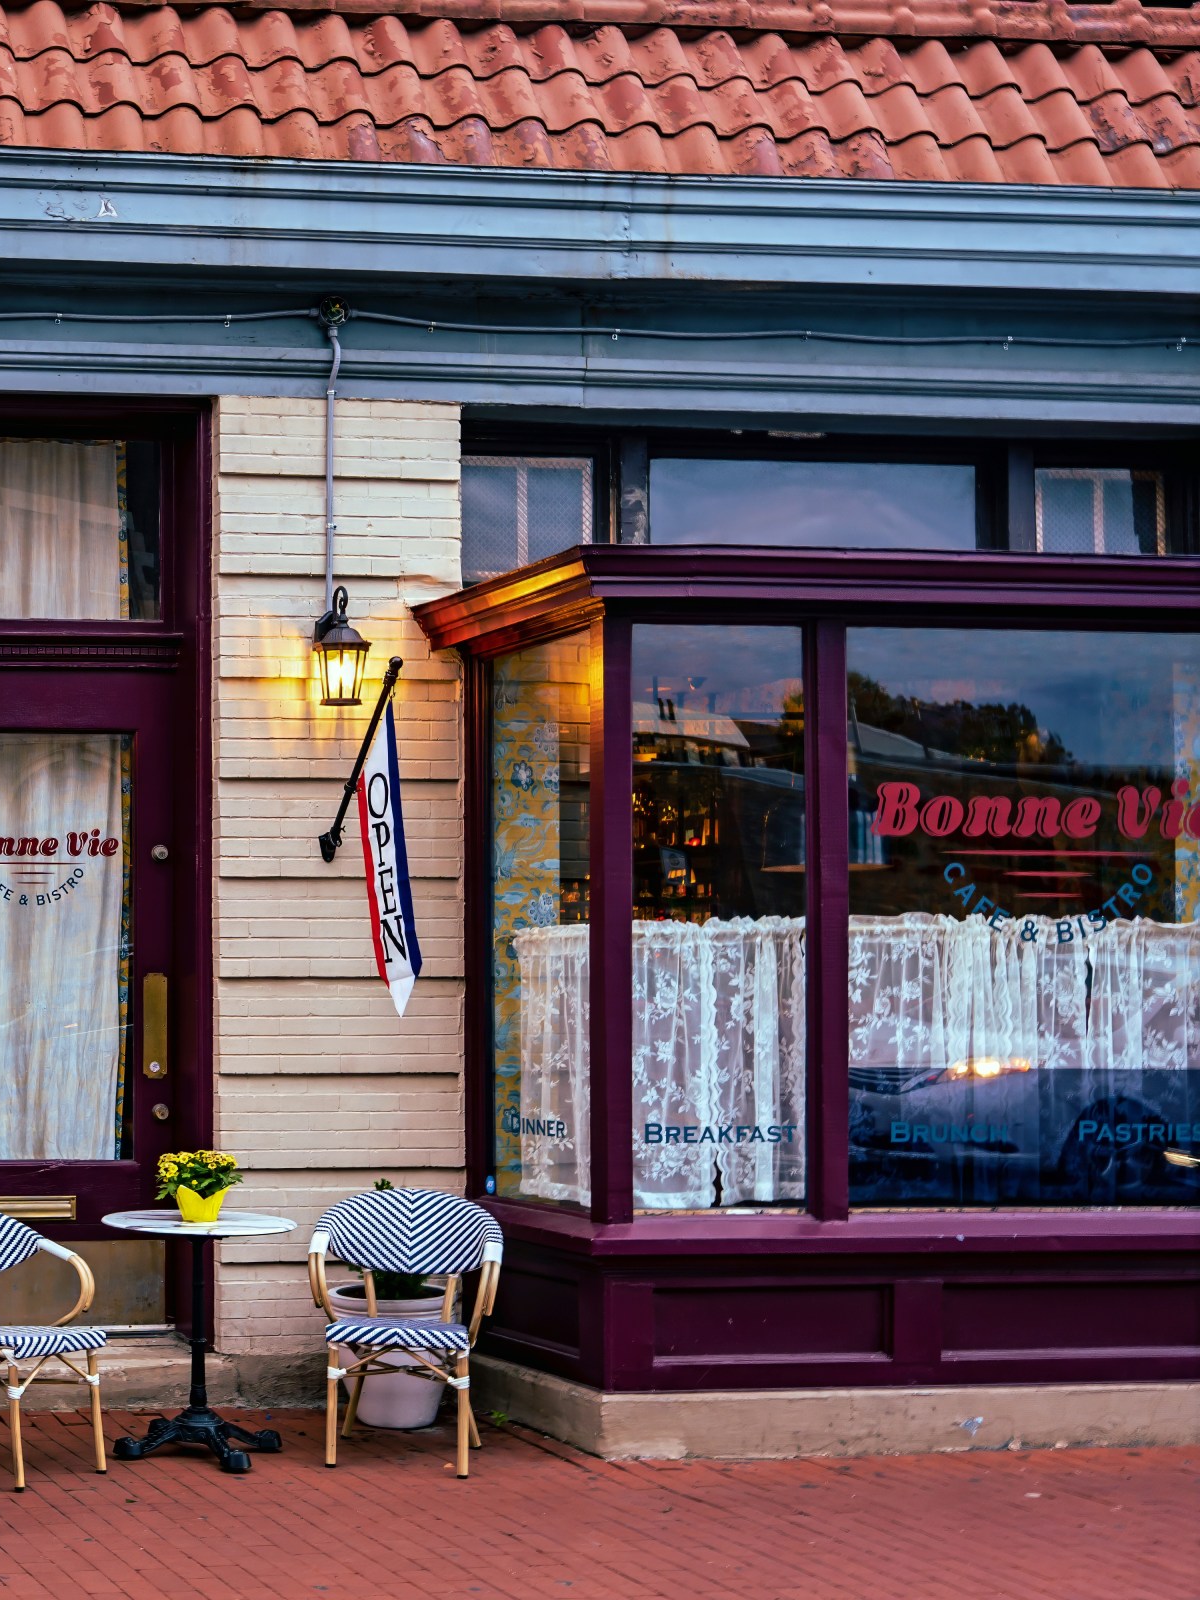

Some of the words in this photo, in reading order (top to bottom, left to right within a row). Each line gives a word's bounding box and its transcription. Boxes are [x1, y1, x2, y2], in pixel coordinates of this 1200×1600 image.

[871, 781, 1102, 839] Bonne
[66, 828, 119, 857] Vie
[366, 772, 408, 964] OPEN
[18, 894, 29, 906] &
[36, 867, 84, 906] BISTRO
[943, 862, 1011, 932] CAFE
[1020, 919, 1039, 943] &
[1056, 862, 1153, 944] BISTRO
